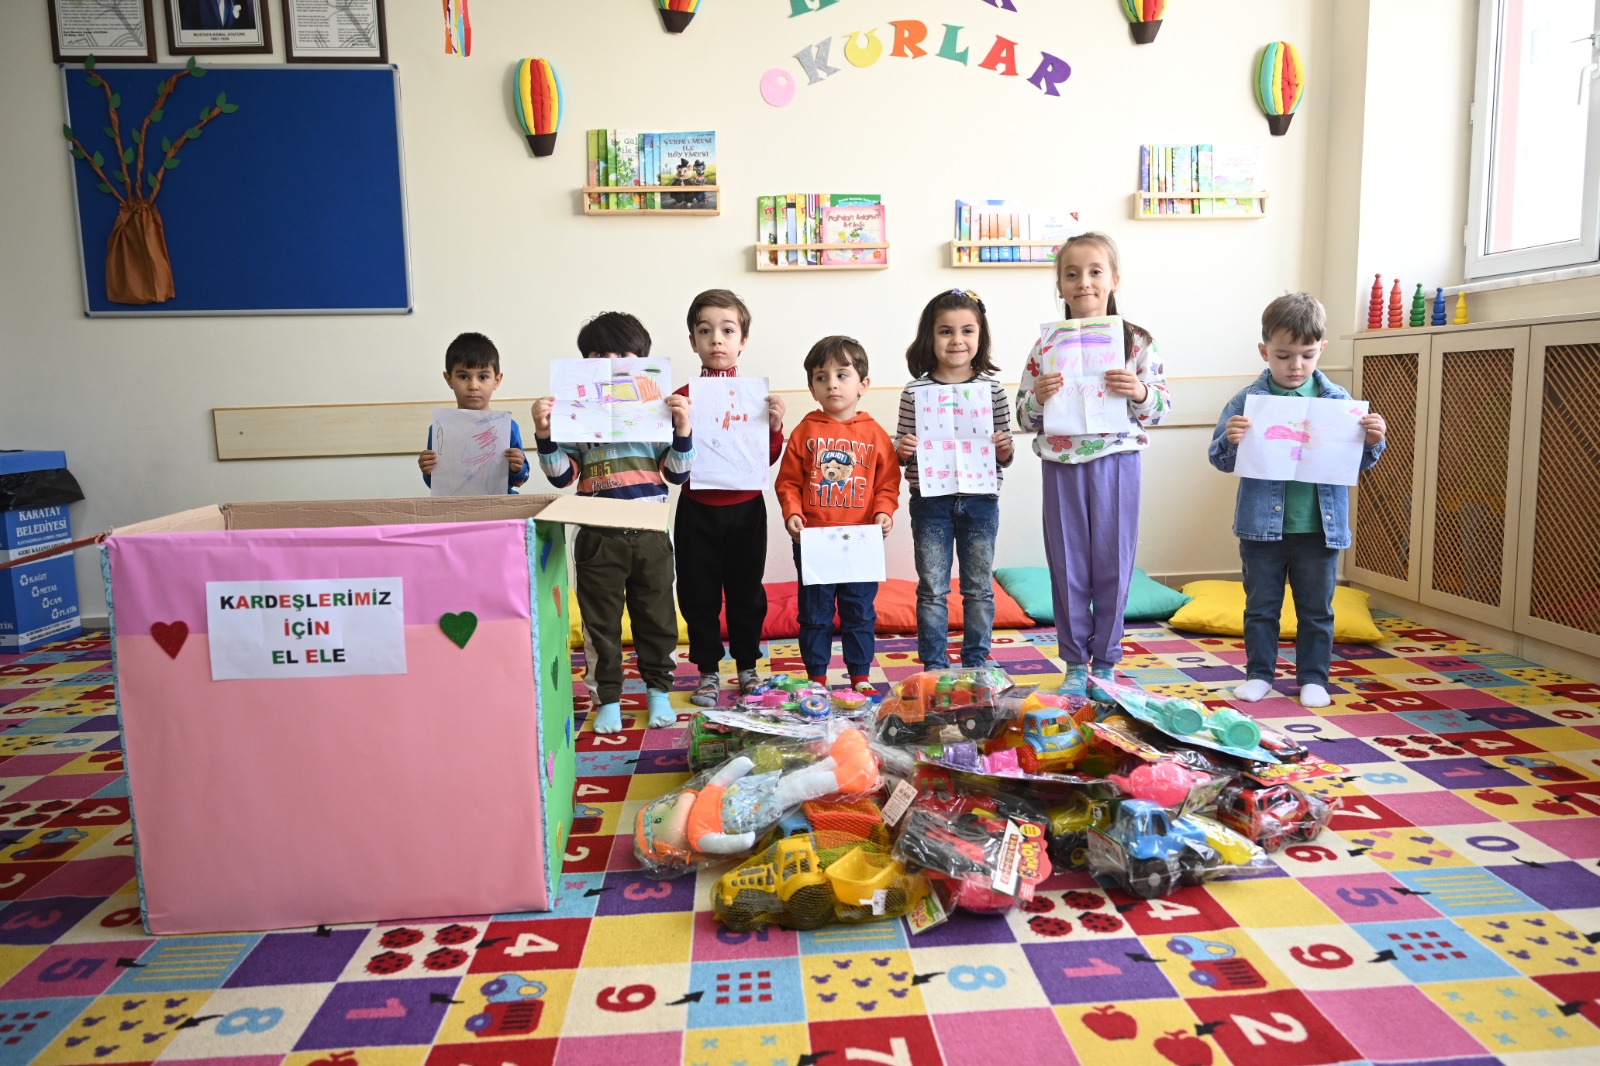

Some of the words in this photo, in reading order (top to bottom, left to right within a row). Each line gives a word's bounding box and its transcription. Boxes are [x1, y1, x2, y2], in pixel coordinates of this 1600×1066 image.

[590, 461, 611, 480] 1985
[809, 475, 867, 509] TIME
[19, 505, 61, 521] KARATAY
[16, 517, 67, 538] BELEDİYESİ
[219, 588, 392, 612] KARDEŞLERİMİZ
[283, 617, 330, 640] İÇİN
[272, 650, 299, 665] EL
[305, 648, 346, 664] ELE
[1360, 772, 1409, 785] 8
[1465, 835, 1521, 852] 0
[623, 881, 673, 901] 3
[1335, 887, 1400, 908] 5
[2, 909, 62, 931] 3
[1146, 898, 1201, 921] 4
[503, 932, 560, 957] 4
[37, 957, 106, 983] 5
[946, 964, 1007, 992] 8
[1062, 957, 1123, 978] 1
[345, 997, 408, 1020] 1
[214, 1006, 285, 1036] 8
[1229, 1011, 1309, 1046] 2
